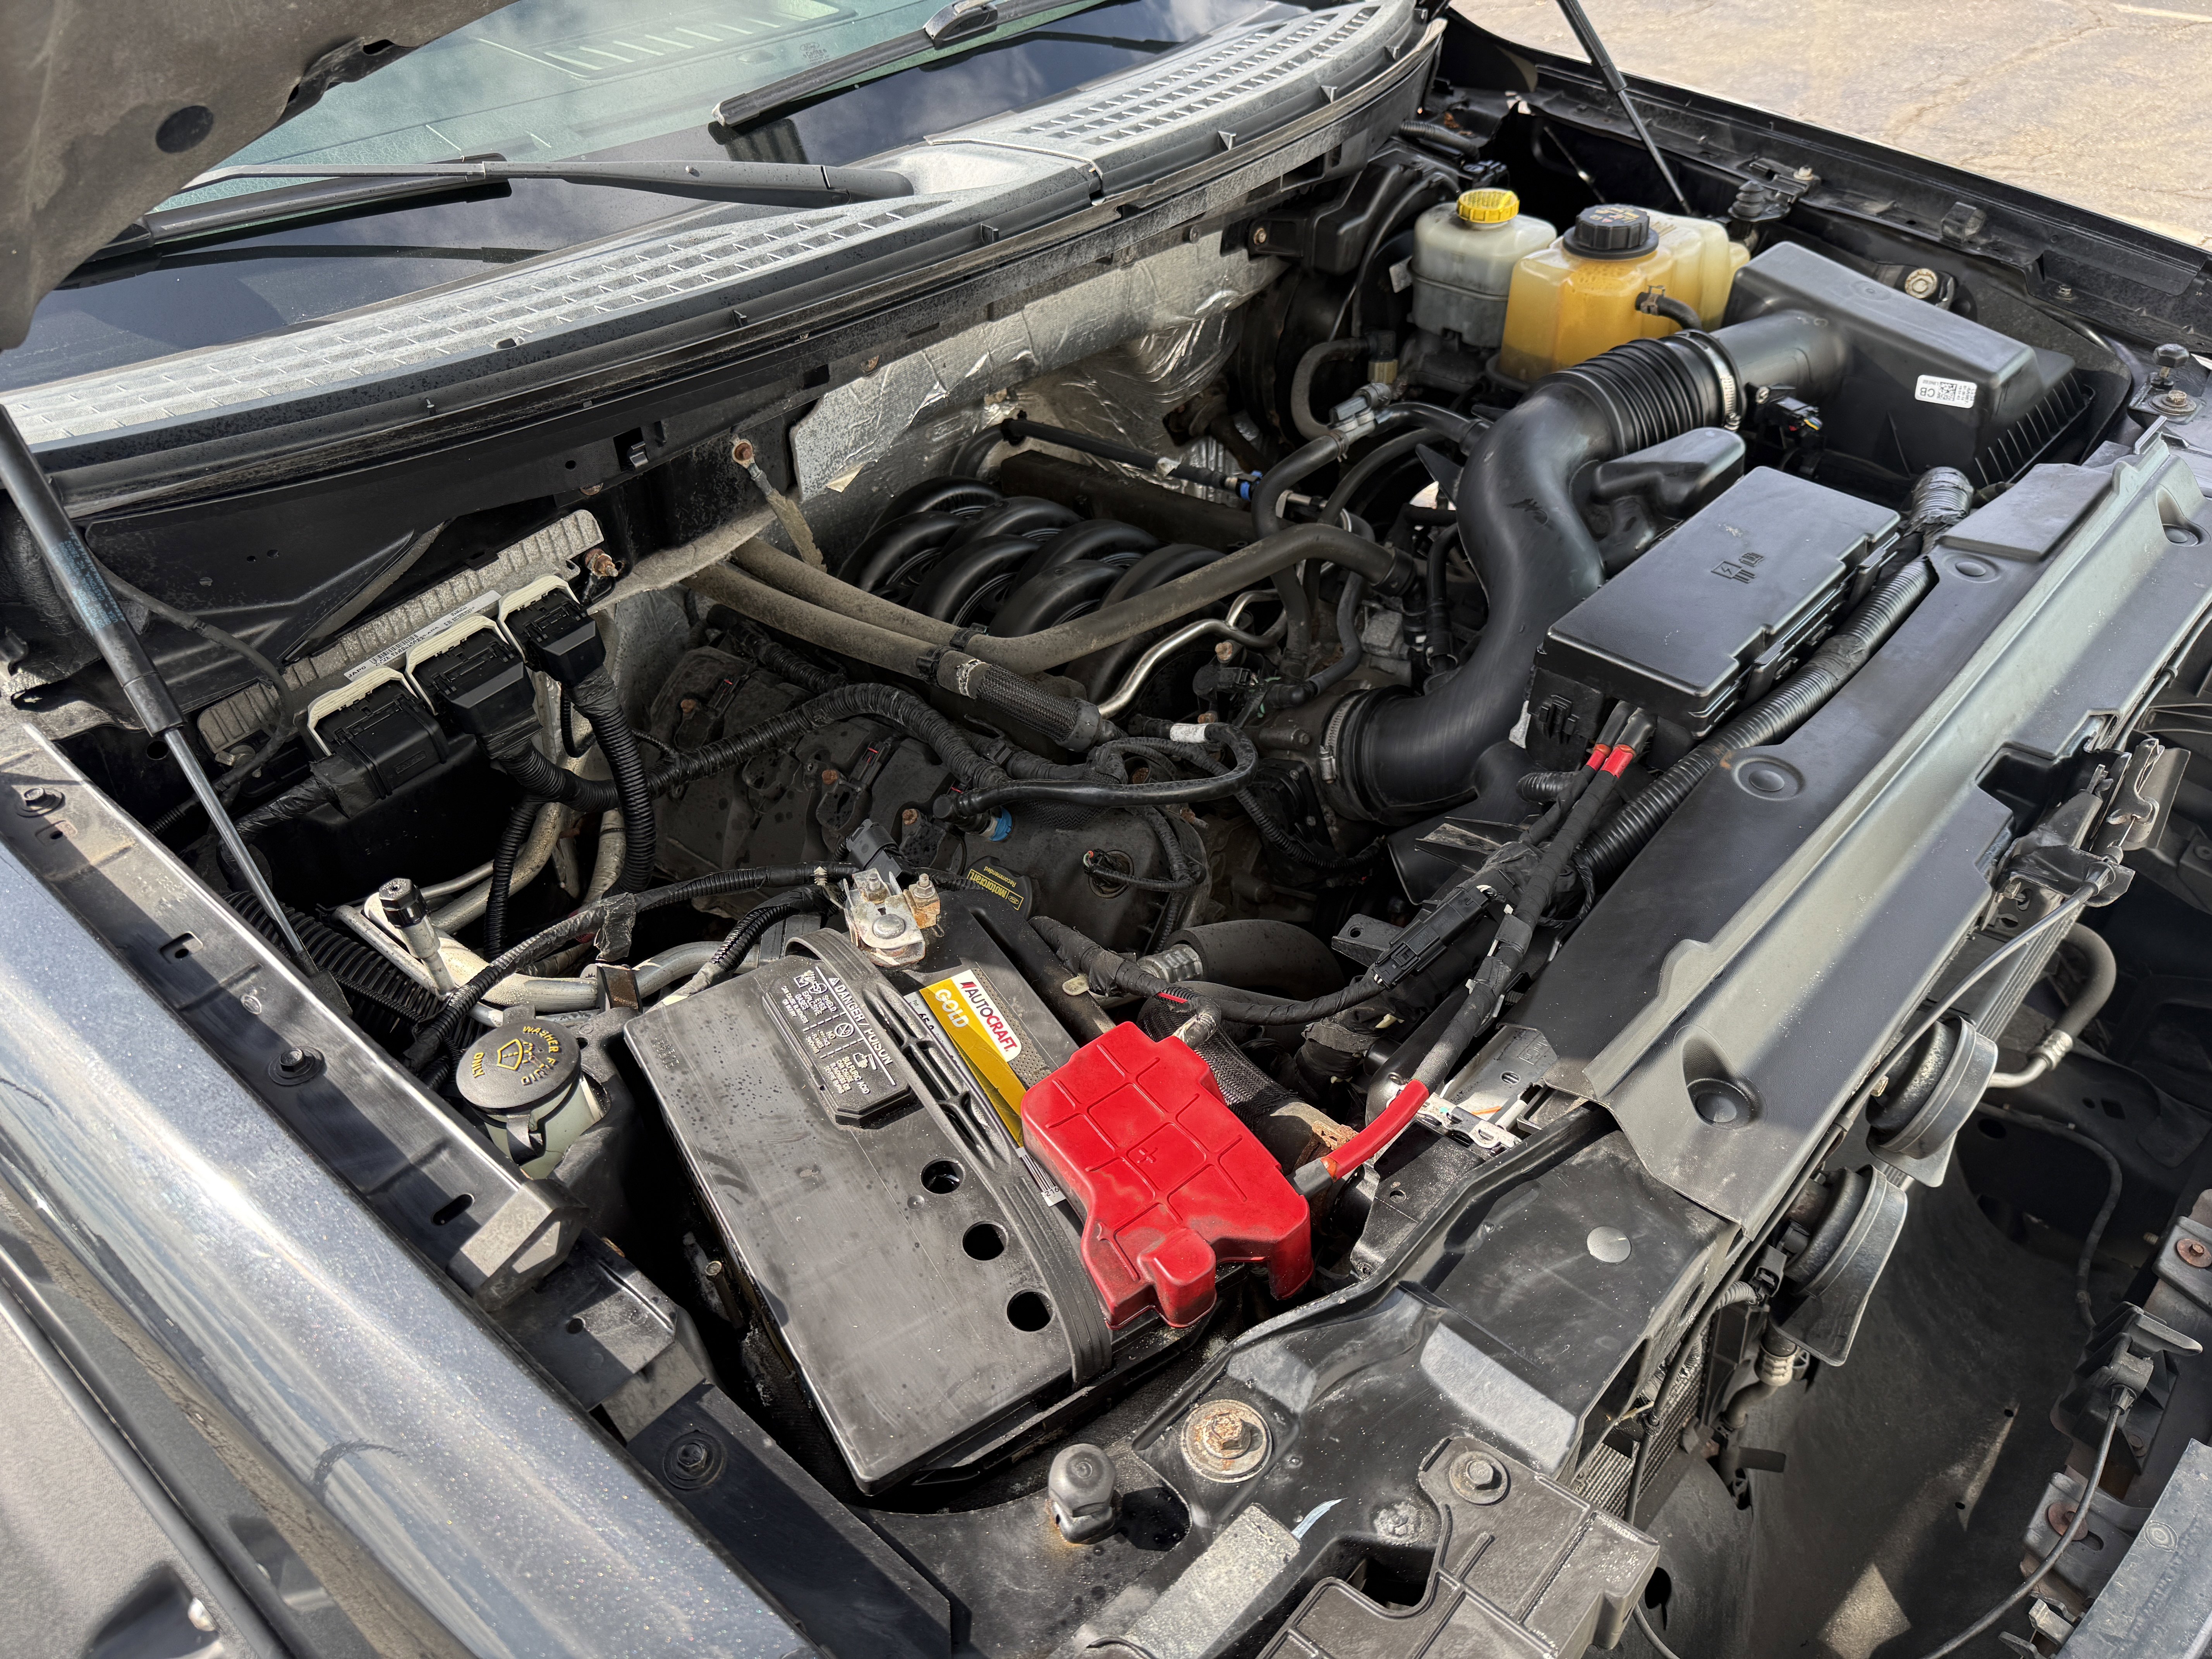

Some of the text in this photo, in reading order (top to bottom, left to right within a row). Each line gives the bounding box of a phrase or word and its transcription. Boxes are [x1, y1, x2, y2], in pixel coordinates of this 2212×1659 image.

[1920, 387, 1935, 398] CB
[62, 562, 72, 575] NOT
[77, 560, 86, 570] NC
[58, 542, 112, 626] OBSERVE DISPOSAL INSTRUCTIONS
[70, 575, 79, 586] DO
[88, 605, 99, 618] NOT
[107, 610, 119, 623] USA
[96, 618, 105, 629] DO
[983, 866, 1017, 888] Recommended
[780, 985, 809, 1024] CAN CAUSE BLINDNESS
[785, 1003, 798, 1018] INJURY
[795, 993, 809, 1011] GASES
[801, 989, 823, 1017] EXPLOSIVE
[821, 994, 838, 1013] SHIELD
[834, 983, 866, 1023] DANGER
[933, 985, 971, 1031] GOLD
[964, 984, 1018, 1053] AUTOCRAFT
[522, 1026, 559, 1053] WASHER
[826, 1029, 836, 1041] NO
[472, 1052, 485, 1078] ONLY
[836, 1059, 854, 1084] CAN CAUSE
[842, 1055, 871, 1096] SULFURIC ACID
[823, 1065, 845, 1095] SEVERE BURNS
[830, 1062, 851, 1092] BLINDNESS OR
